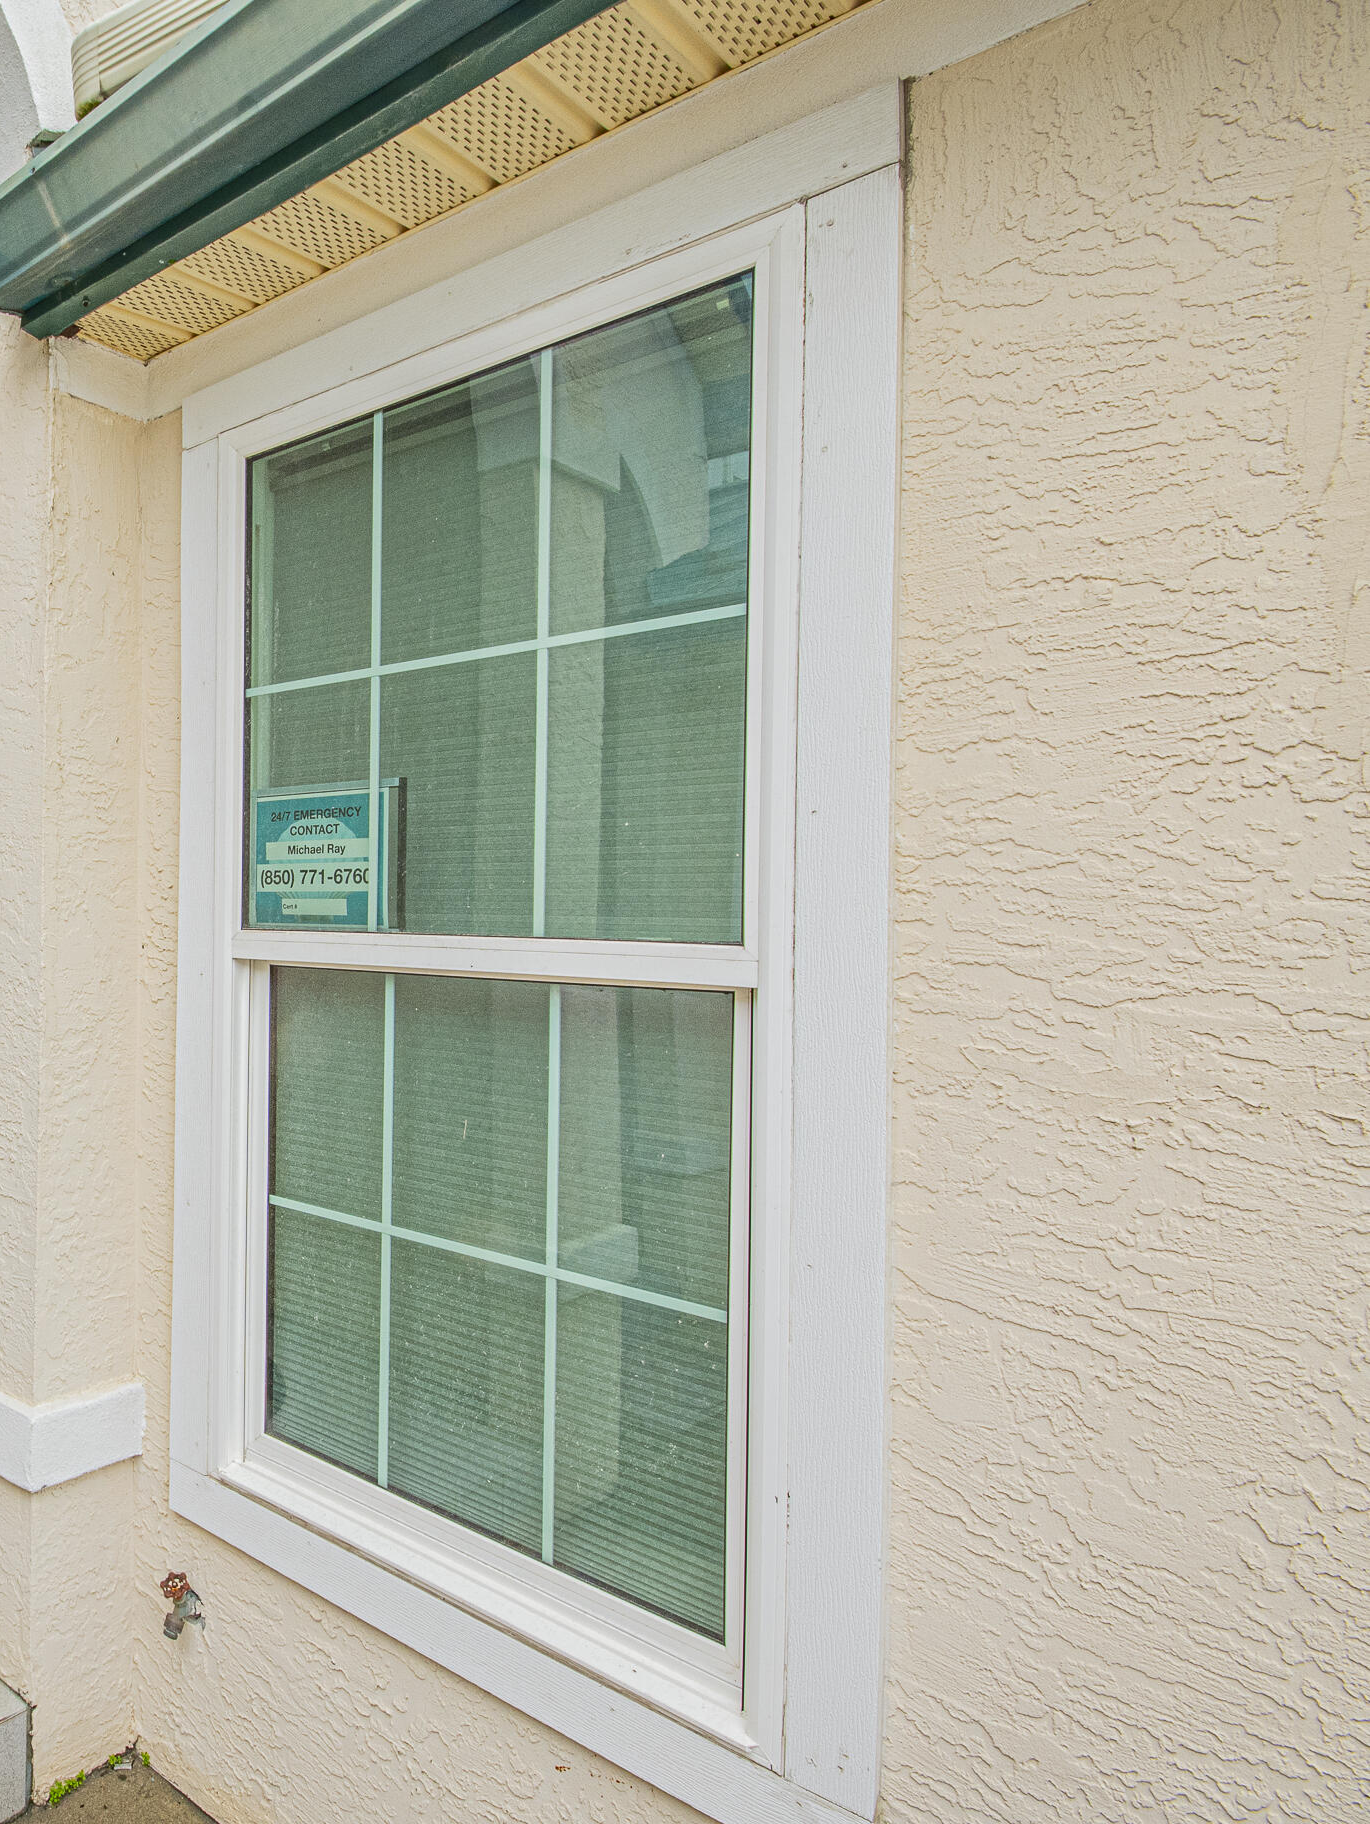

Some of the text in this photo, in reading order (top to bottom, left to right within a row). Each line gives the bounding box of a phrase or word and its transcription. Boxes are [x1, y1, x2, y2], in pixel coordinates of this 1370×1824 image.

[271, 806, 362, 822] 24/7 EMERGENCY
[290, 824, 340, 836] CONTACT
[287, 844, 346, 856] Michael Ray
[261, 869, 295, 888] (850)
